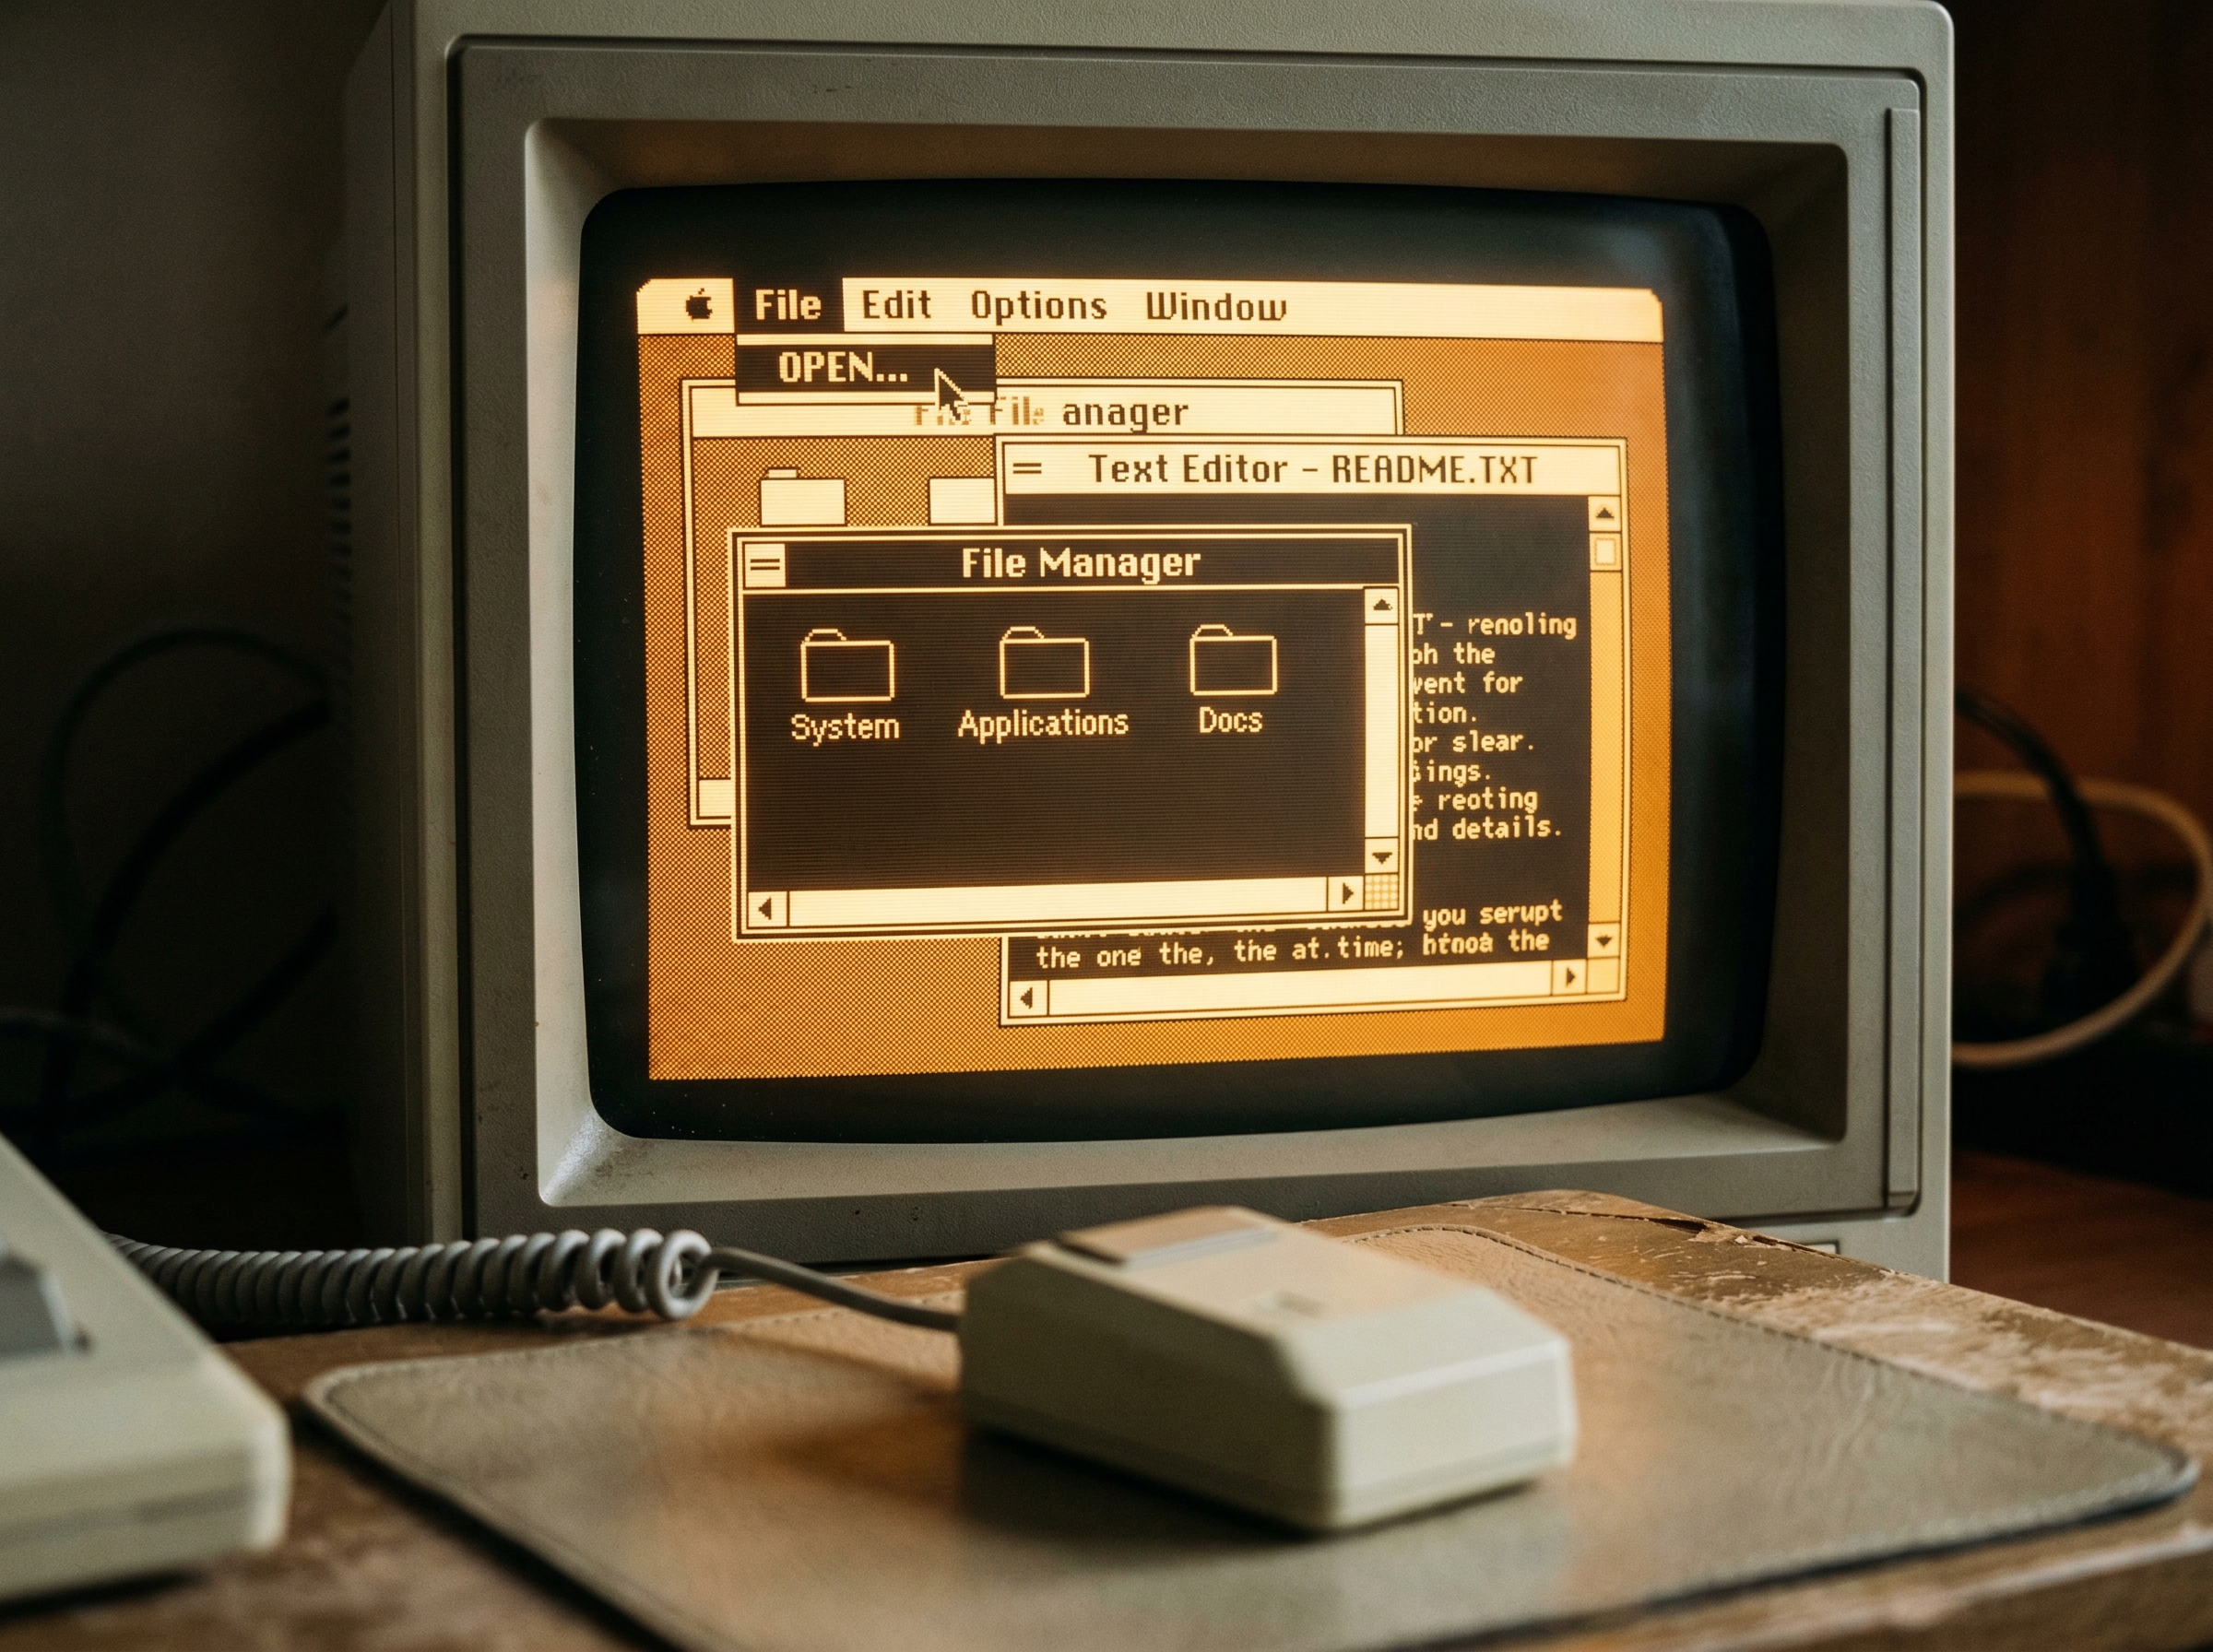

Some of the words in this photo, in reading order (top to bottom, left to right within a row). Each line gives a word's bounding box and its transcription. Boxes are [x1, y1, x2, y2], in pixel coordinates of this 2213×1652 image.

[755, 289, 822, 321] File
[862, 289, 931, 319] Edit
[971, 289, 1107, 327] Options
[1146, 291, 1287, 322] Window
[778, 351, 908, 383] OPEN...
[1088, 454, 1168, 483] Text
[1183, 454, 1288, 483] Editor
[1332, 454, 1538, 484] README.TXT
[962, 547, 1026, 578] File
[1039, 547, 1201, 584] Manager
[1468, 611, 1577, 641] renoling
[1452, 642, 1496, 665] the
[1482, 670, 1523, 694] for
[790, 712, 900, 748] System
[957, 708, 1130, 745] Applications
[1199, 705, 1263, 734] Docs
[1452, 729, 1533, 753] slear.
[1451, 815, 1561, 839] details.
[1422, 908, 1466, 932] you
[1479, 899, 1563, 926] serupt
[1035, 946, 1082, 969] the
[1096, 948, 1142, 968] one
[1158, 941, 1214, 966] the,
[1234, 938, 1277, 962] the
[1508, 928, 1550, 952] the
